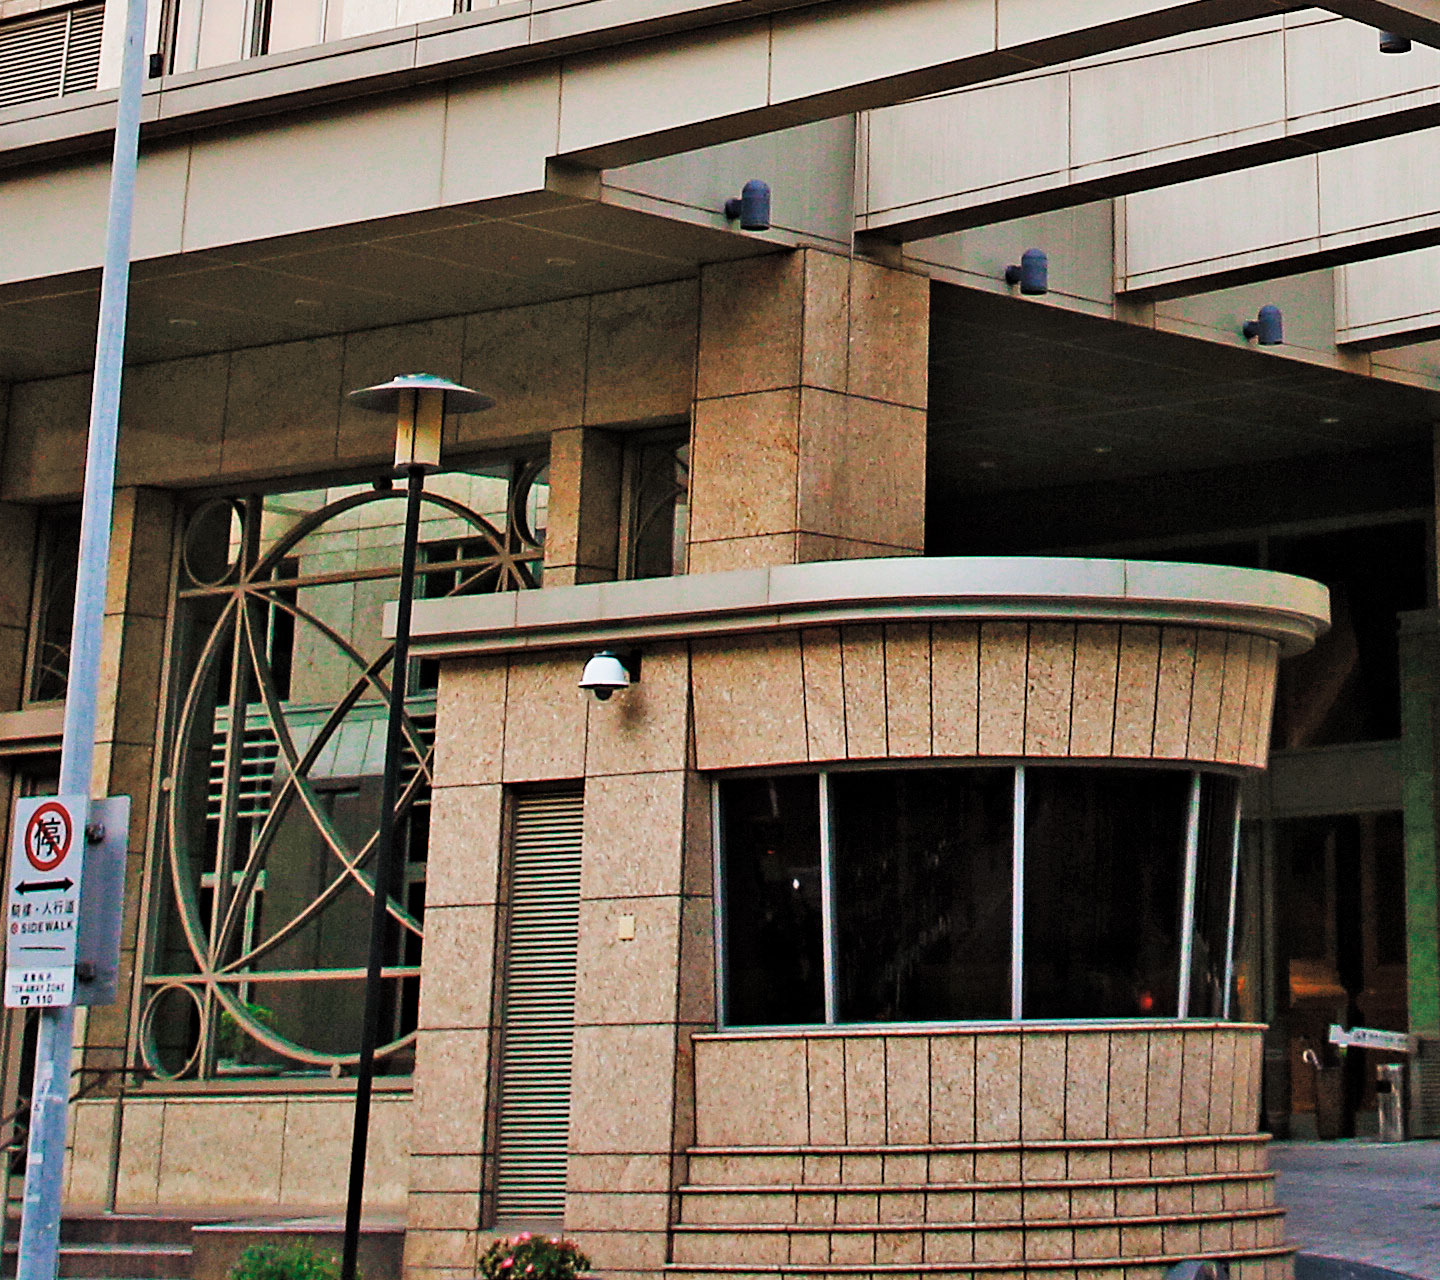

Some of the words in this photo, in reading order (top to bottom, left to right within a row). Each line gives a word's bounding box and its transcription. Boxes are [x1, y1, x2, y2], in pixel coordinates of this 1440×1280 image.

[33, 817, 62, 857] 停
[21, 920, 73, 934] SIDEWALK
[36, 994, 53, 1005] 110
